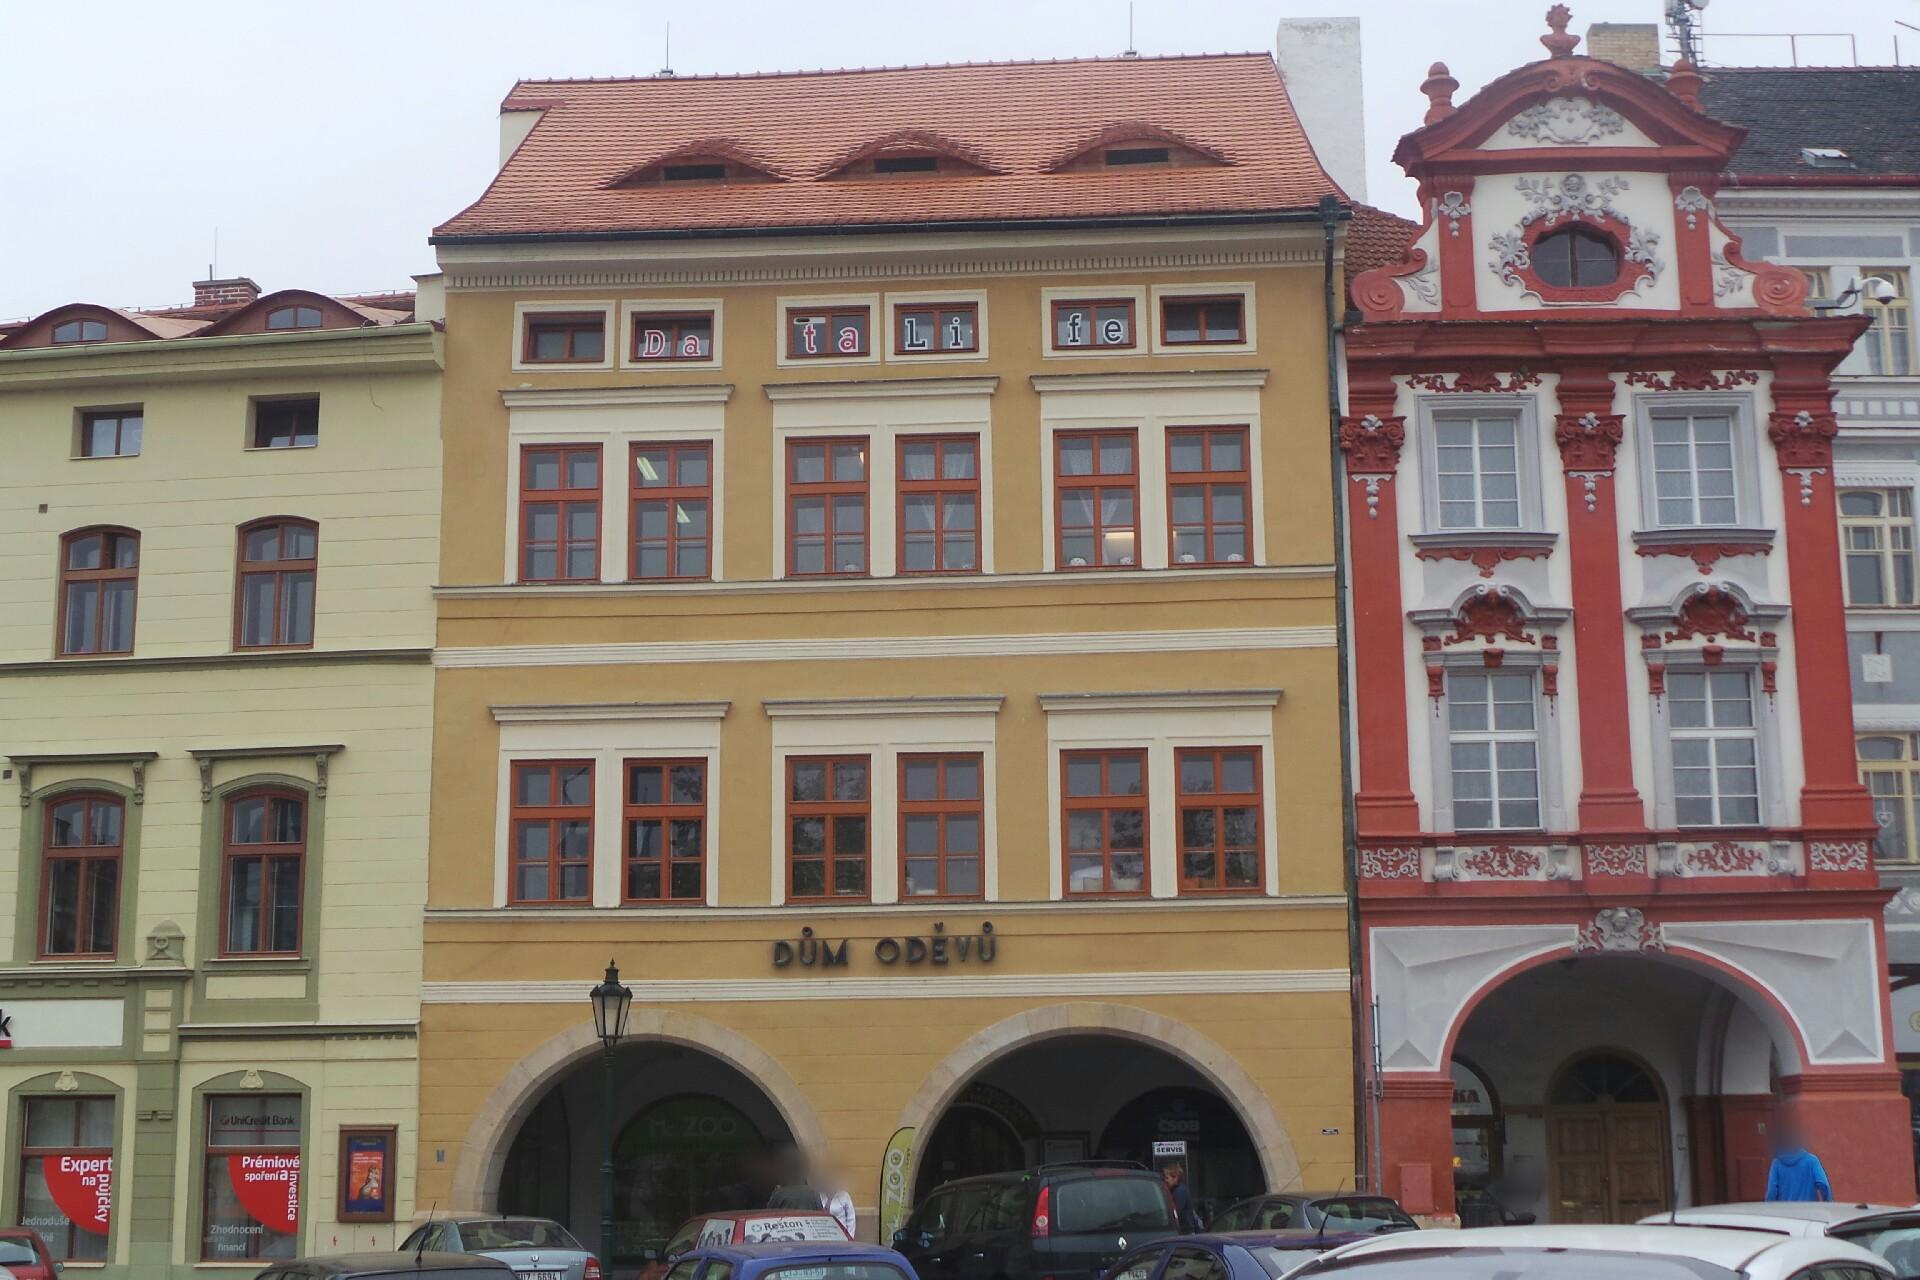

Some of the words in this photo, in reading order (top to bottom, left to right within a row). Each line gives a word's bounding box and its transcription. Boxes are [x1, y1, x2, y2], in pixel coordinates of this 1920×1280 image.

[772, 926, 848, 966] DŮM
[875, 921, 997, 965] ODĚVŮ
[230, 1115, 270, 1127] UniCredit
[272, 1114, 295, 1126] Bank
[60, 1156, 113, 1175] Expert
[242, 1155, 300, 1168] Prémiové
[82, 1176, 96, 1186] na
[244, 1170, 279, 1182] spoření
[280, 1170, 288, 1180] a
[287, 1171, 300, 1221] investice
[210, 1223, 264, 1234] Zhodnocení
[764, 1220, 803, 1231] Reston
